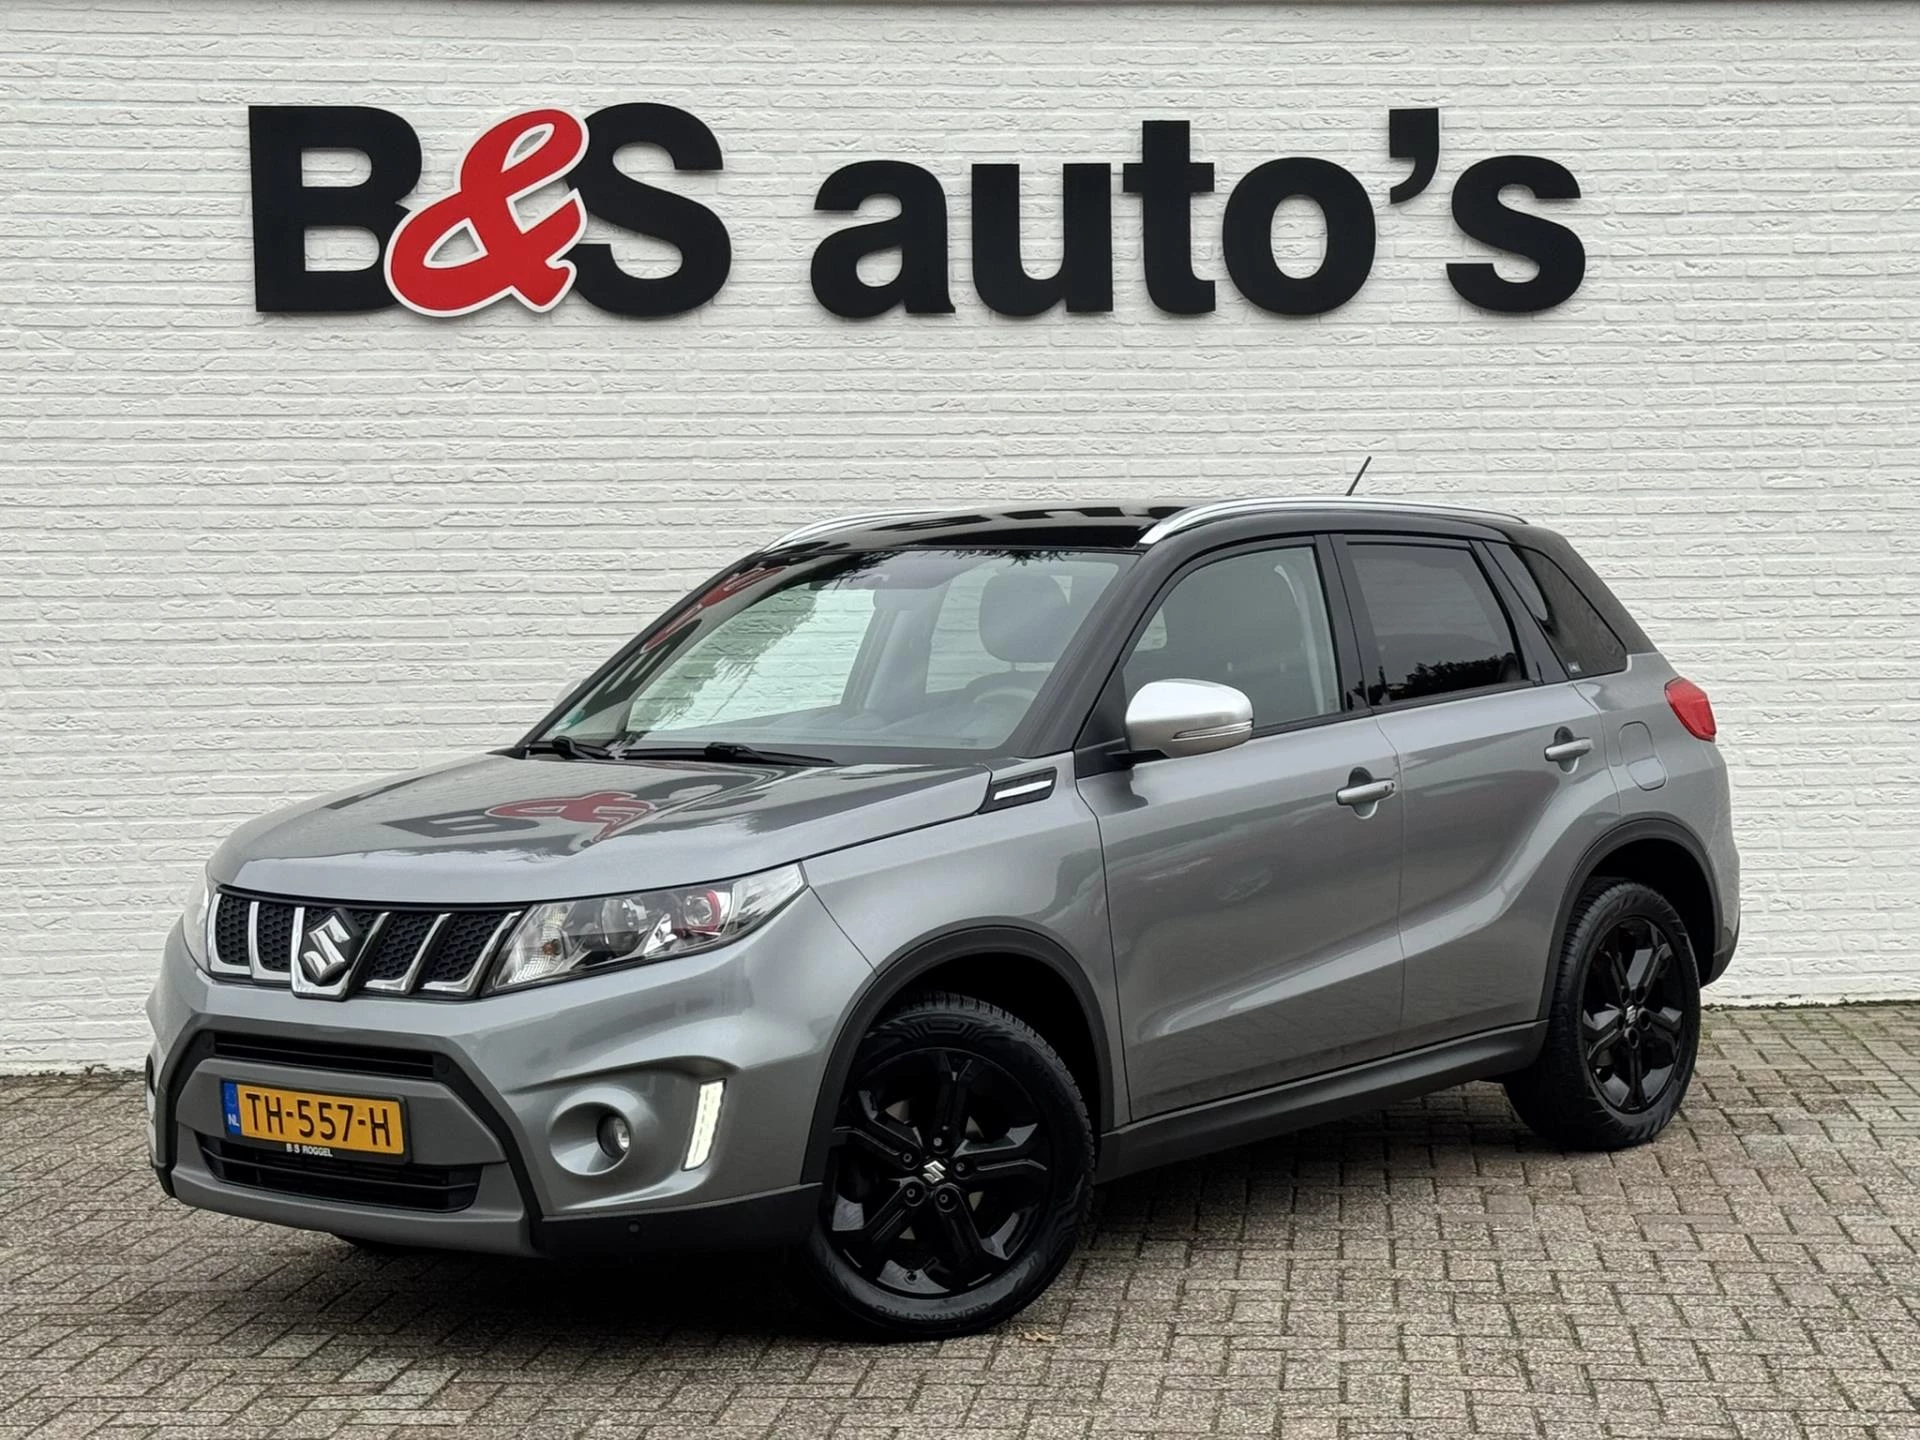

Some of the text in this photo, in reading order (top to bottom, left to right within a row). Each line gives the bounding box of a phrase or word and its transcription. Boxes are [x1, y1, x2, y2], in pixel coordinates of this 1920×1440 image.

[249, 103, 1585, 319] B&S auto's
[228, 1113, 240, 1127] NL
[245, 1092, 392, 1147] TH-557-H
[302, 1144, 334, 1158] ROGGEL
